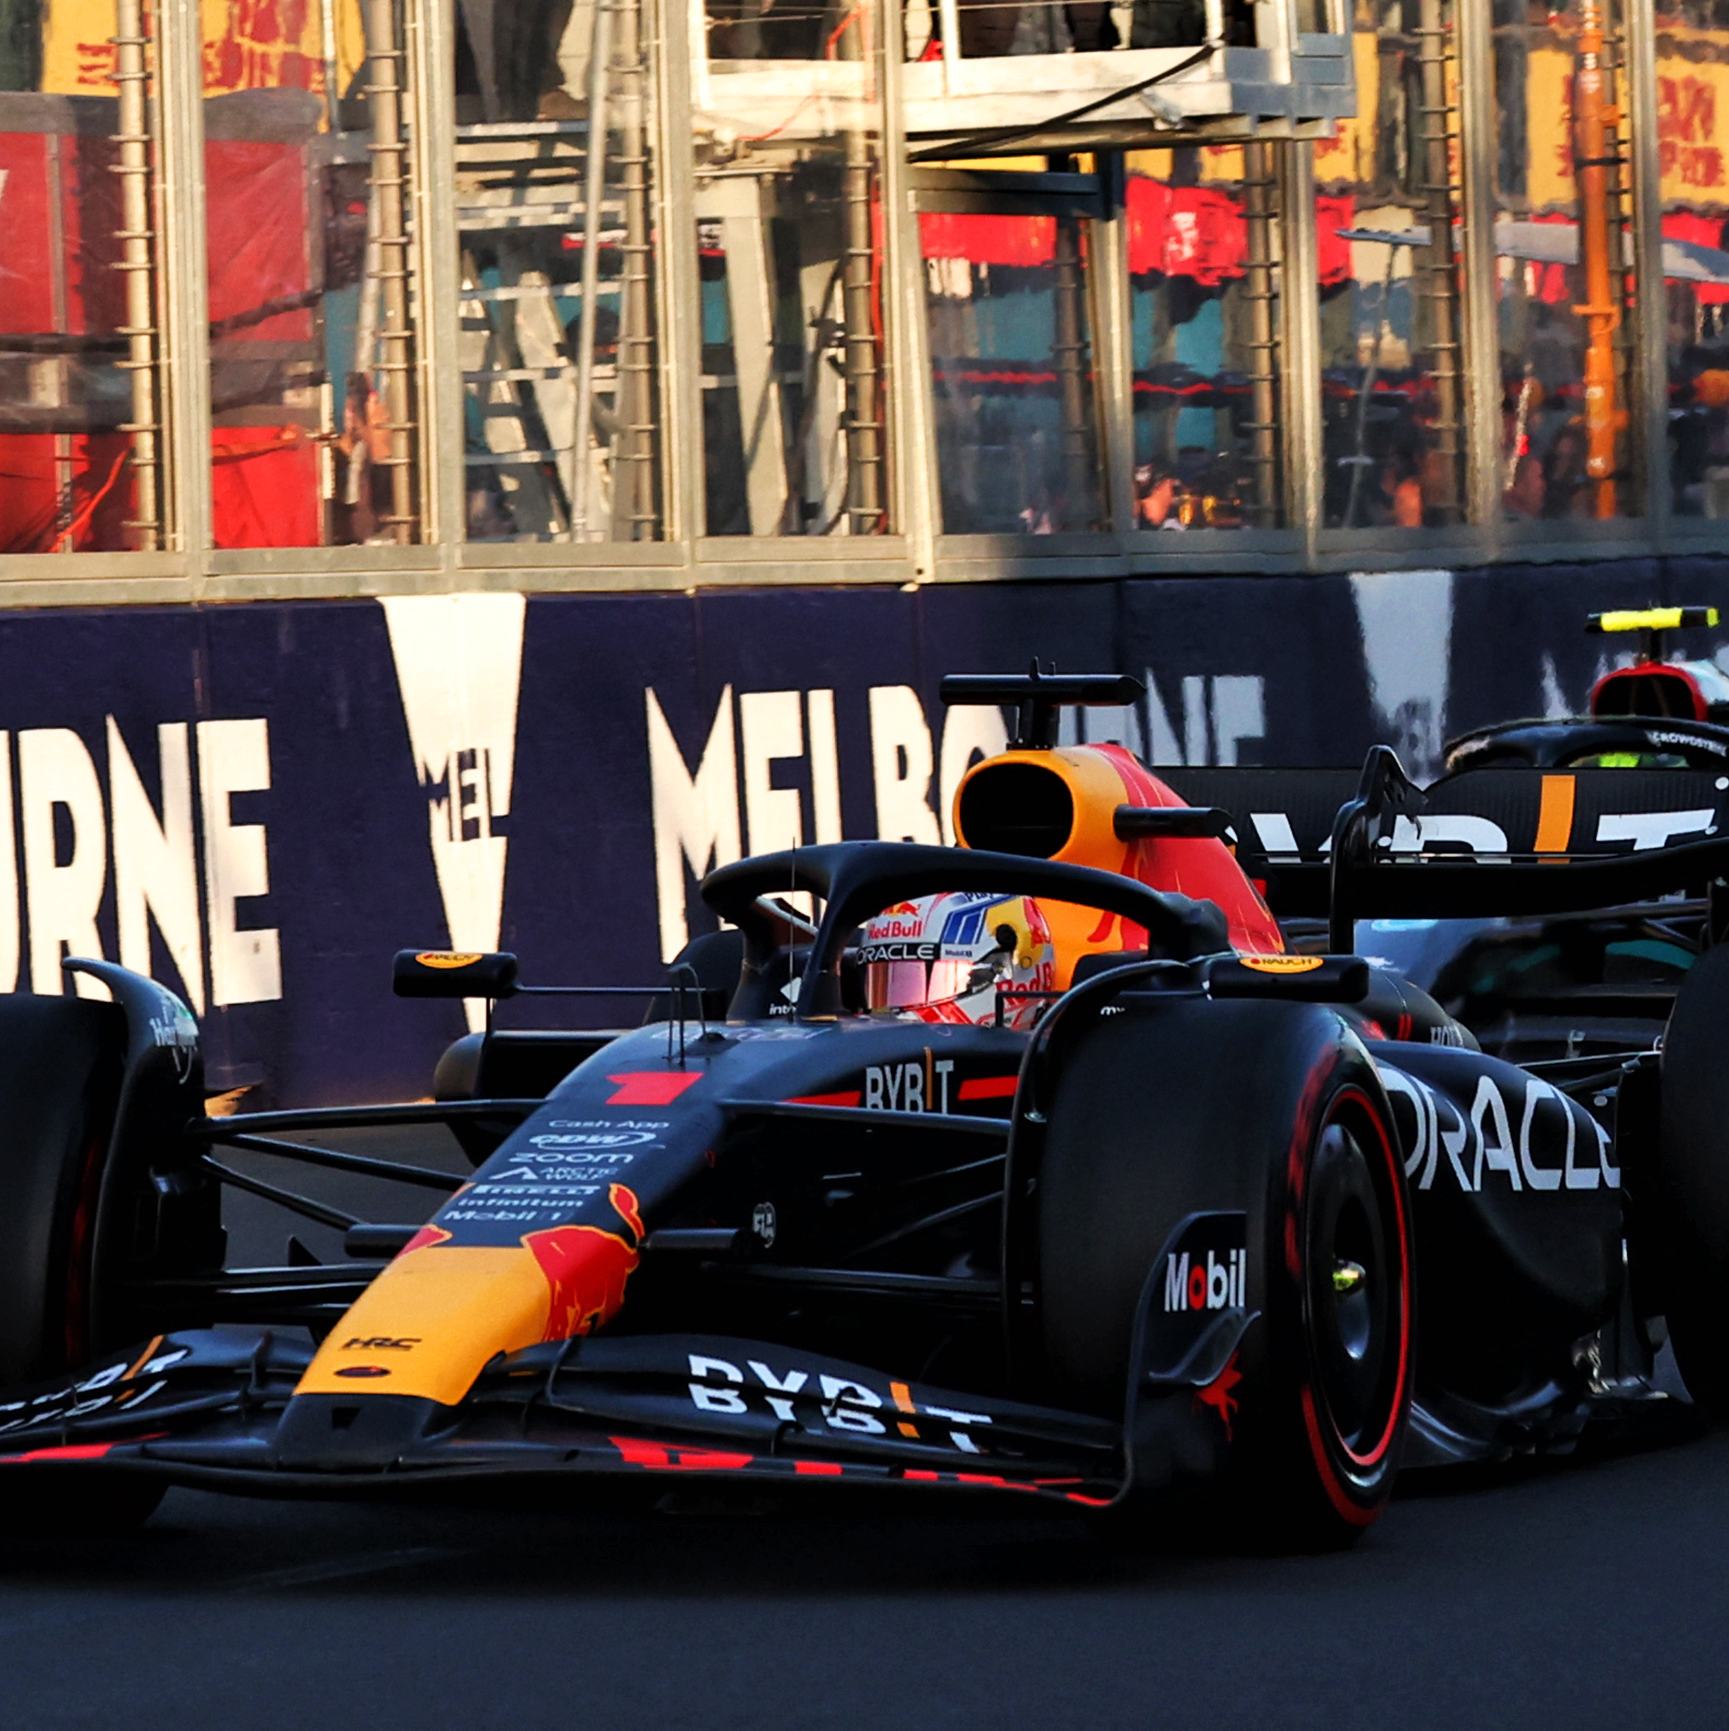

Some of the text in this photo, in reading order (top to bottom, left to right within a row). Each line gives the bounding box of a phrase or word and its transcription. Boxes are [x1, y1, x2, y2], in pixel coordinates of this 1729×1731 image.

[892, 921, 922, 937] Bull
[856, 943, 935, 965] ORACLE
[865, 1046, 954, 1116] BYBIT
[549, 1120, 669, 1130] Cash App
[509, 1152, 634, 1163] zoom
[458, 1198, 584, 1207] infinitum
[444, 1210, 538, 1220] Mobil
[1164, 1248, 1246, 1312] Mobil
[687, 1355, 992, 1454] BYBIT
